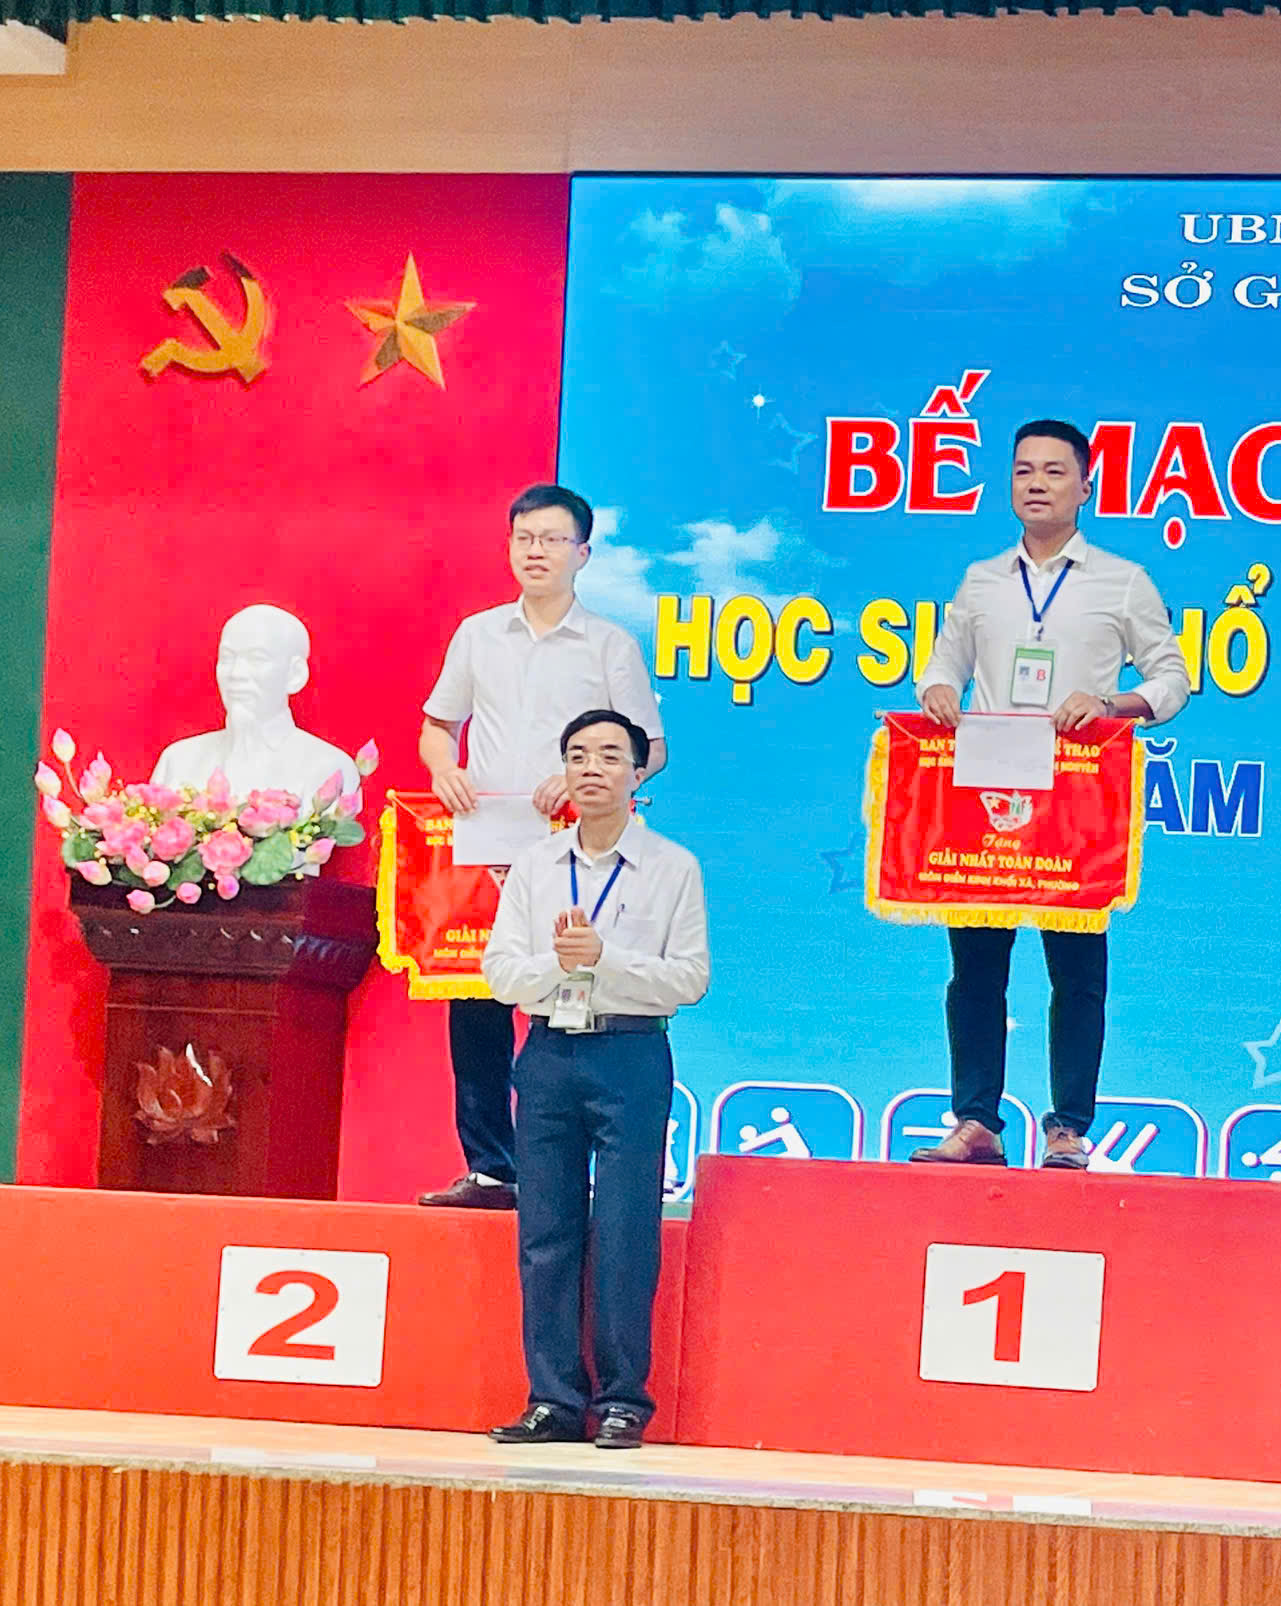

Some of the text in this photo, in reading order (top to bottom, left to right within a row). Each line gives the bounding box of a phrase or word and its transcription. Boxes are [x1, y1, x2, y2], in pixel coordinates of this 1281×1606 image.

[1121, 262, 1214, 309] SỞ
[822, 369, 991, 516] BẾ
[654, 594, 834, 706] HỌC
[1143, 737, 1265, 837] ĂM
[248, 1271, 339, 1361] 2
[962, 1271, 1026, 1363] 1
